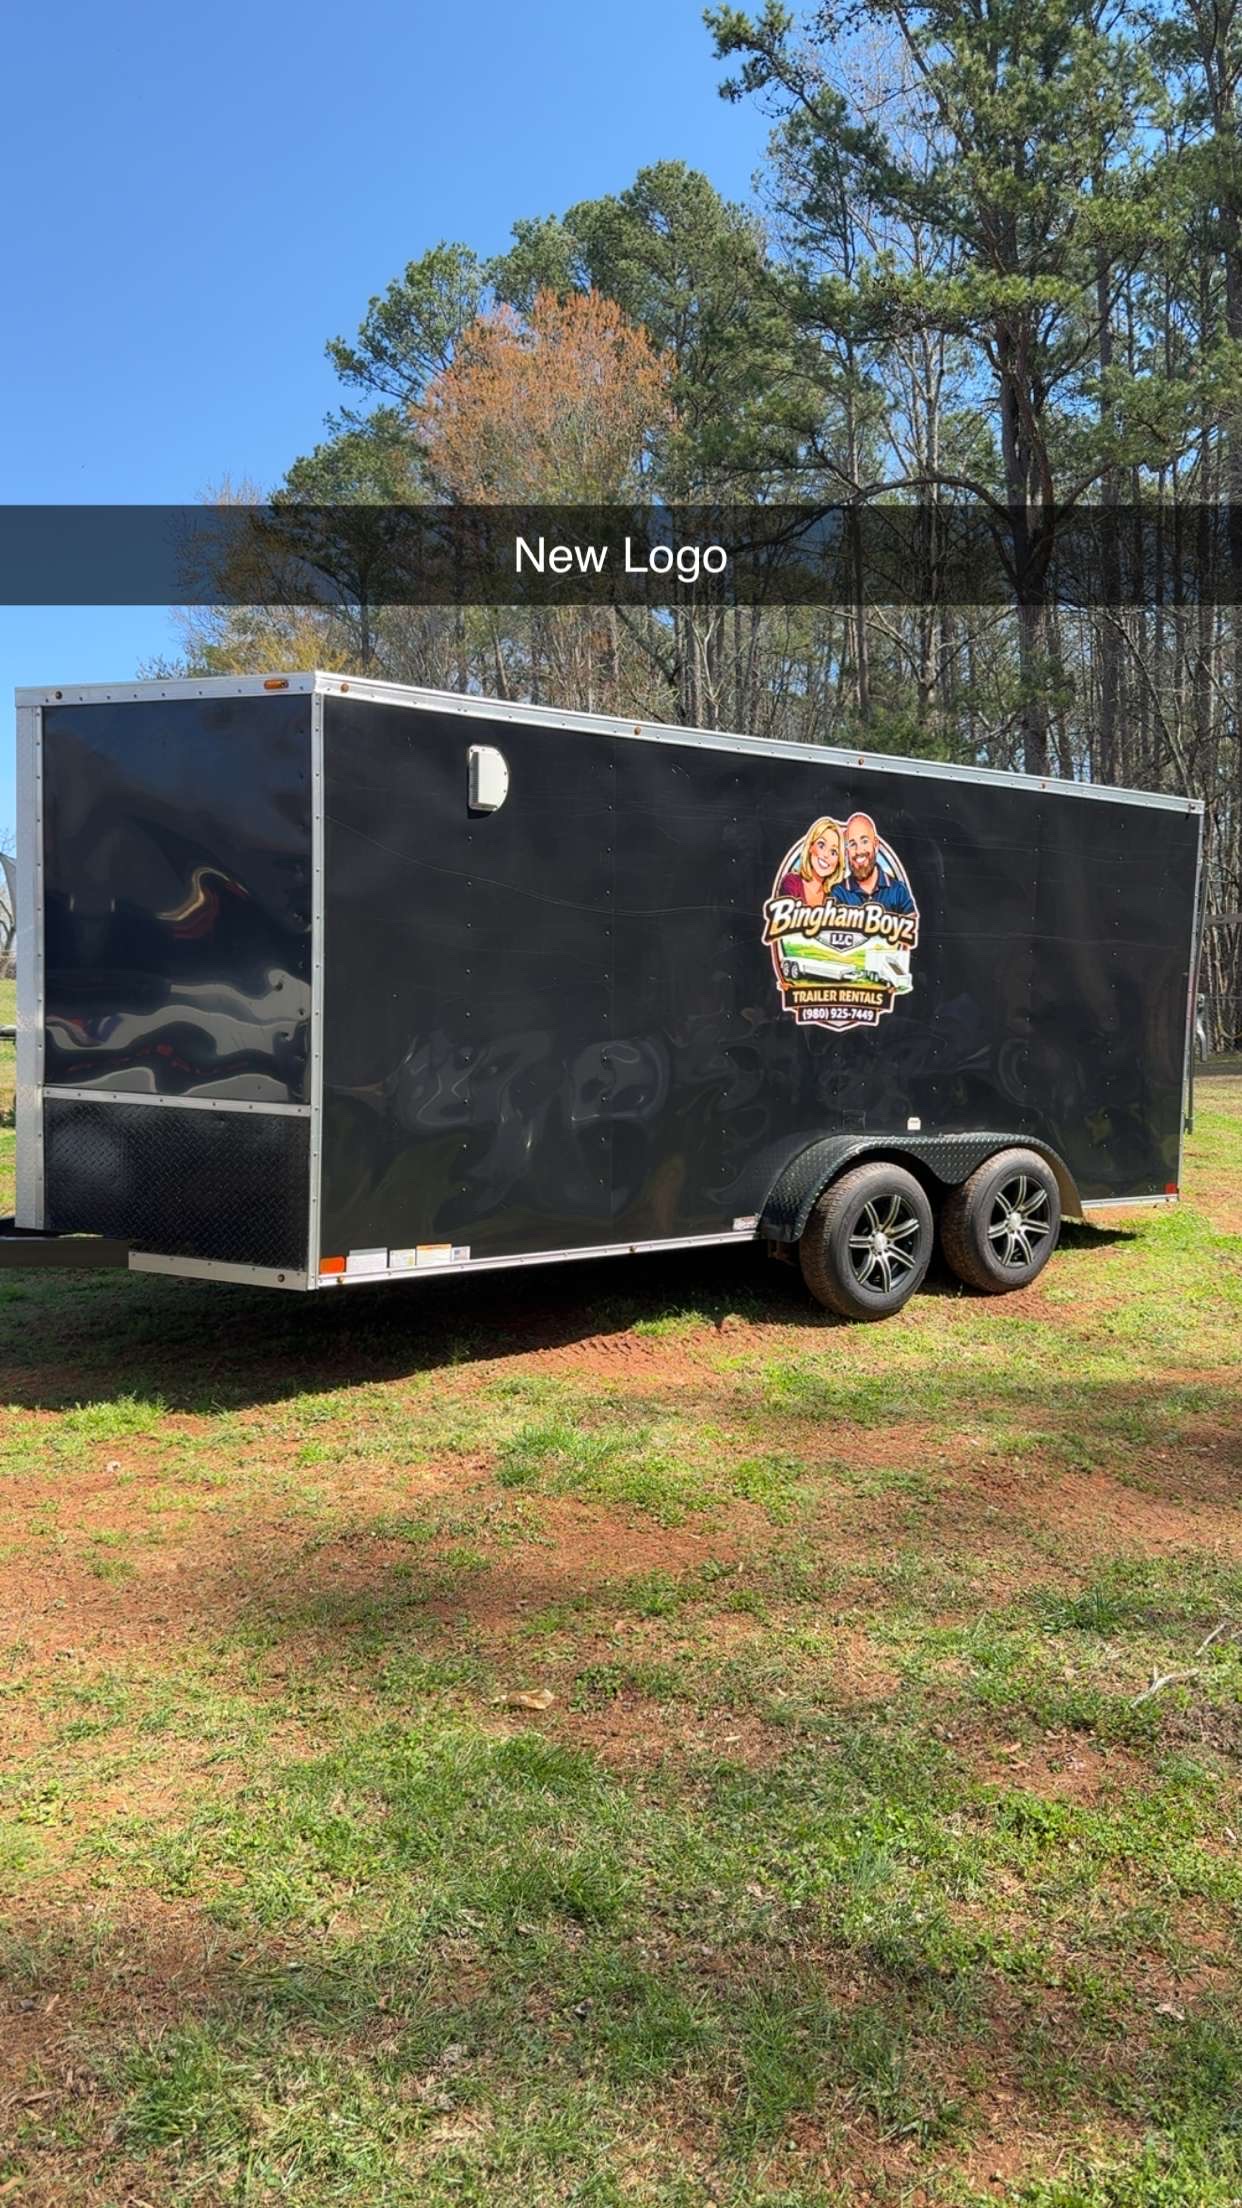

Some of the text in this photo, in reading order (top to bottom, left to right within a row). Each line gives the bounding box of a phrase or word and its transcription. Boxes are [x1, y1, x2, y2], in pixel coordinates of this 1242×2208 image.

[831, 933, 853, 945] LLC
[792, 989, 883, 1005] TRAILER RENTALS
[802, 1008, 874, 1021] (980) 925-7449
